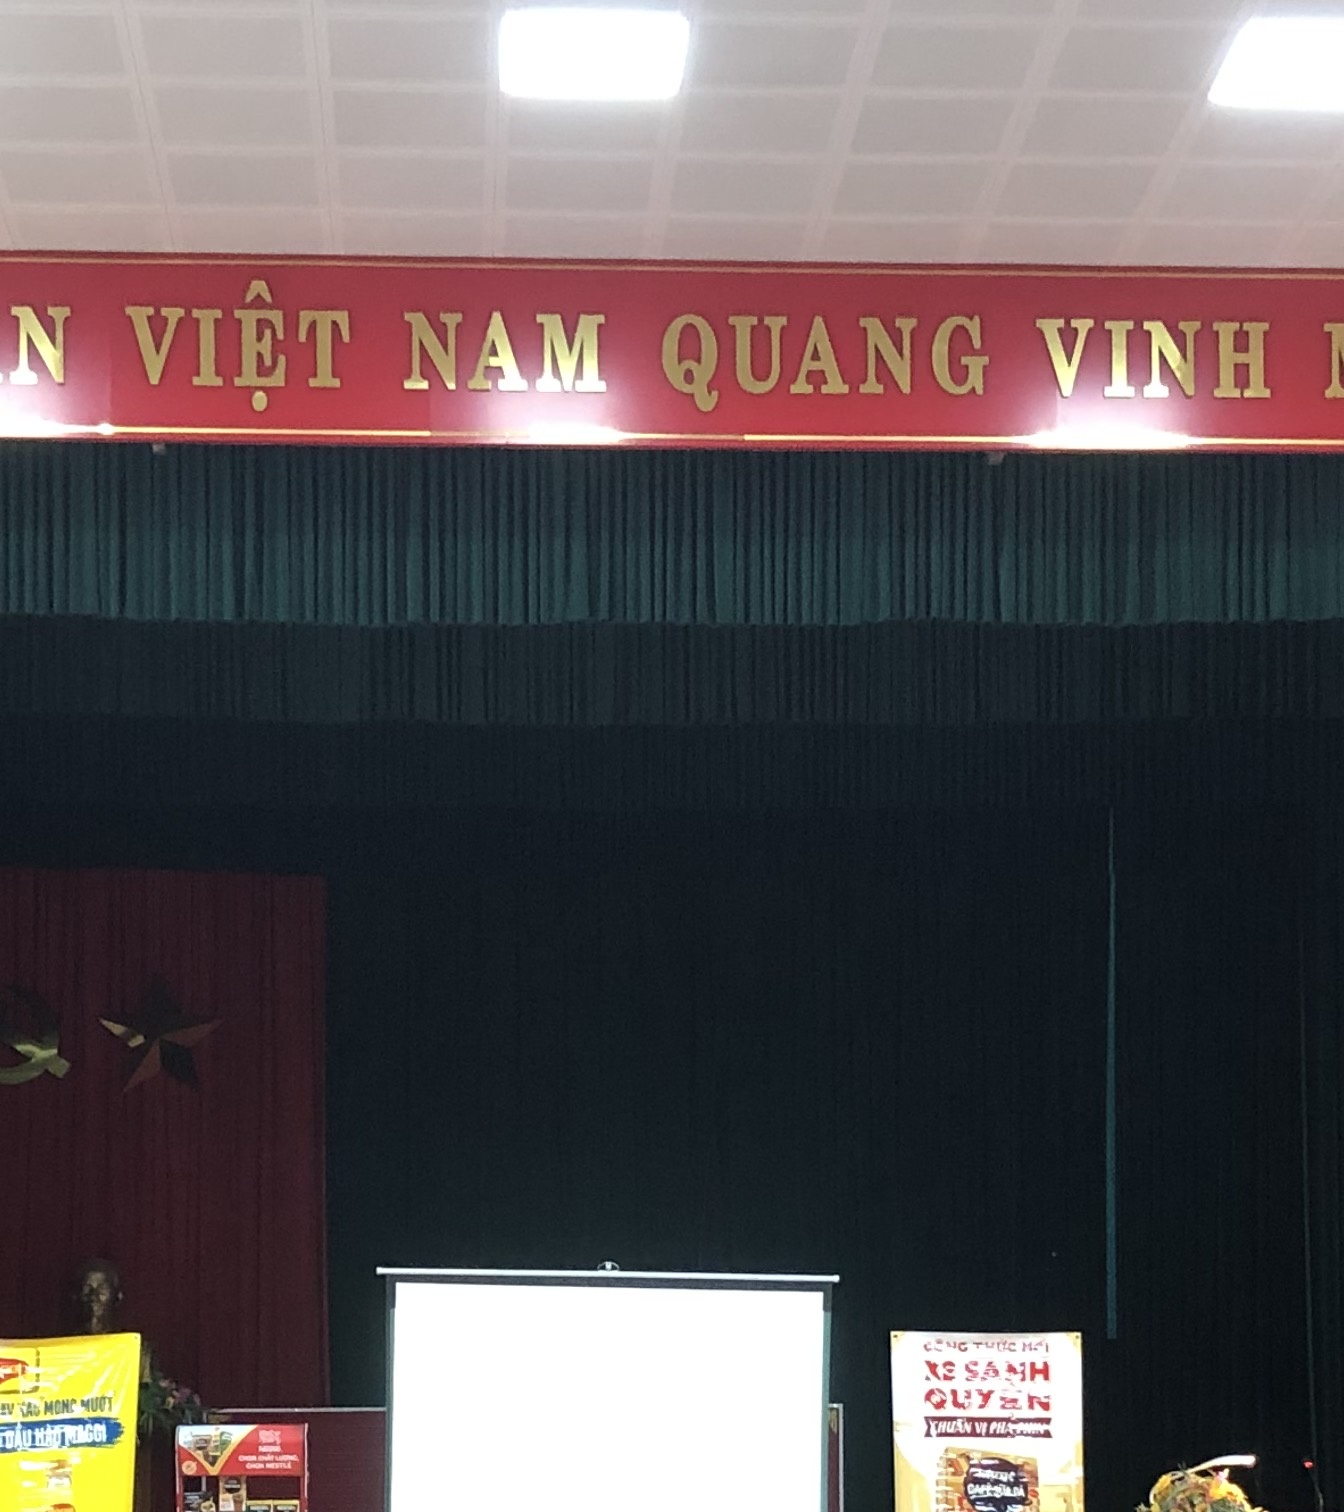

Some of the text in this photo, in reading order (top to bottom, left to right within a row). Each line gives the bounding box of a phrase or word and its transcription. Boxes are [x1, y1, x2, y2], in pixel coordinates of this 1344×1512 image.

[125, 280, 351, 412] VIỆT
[403, 311, 607, 394] NAM
[661, 314, 990, 412] QUANG
[1036, 317, 1271, 400] VINH
